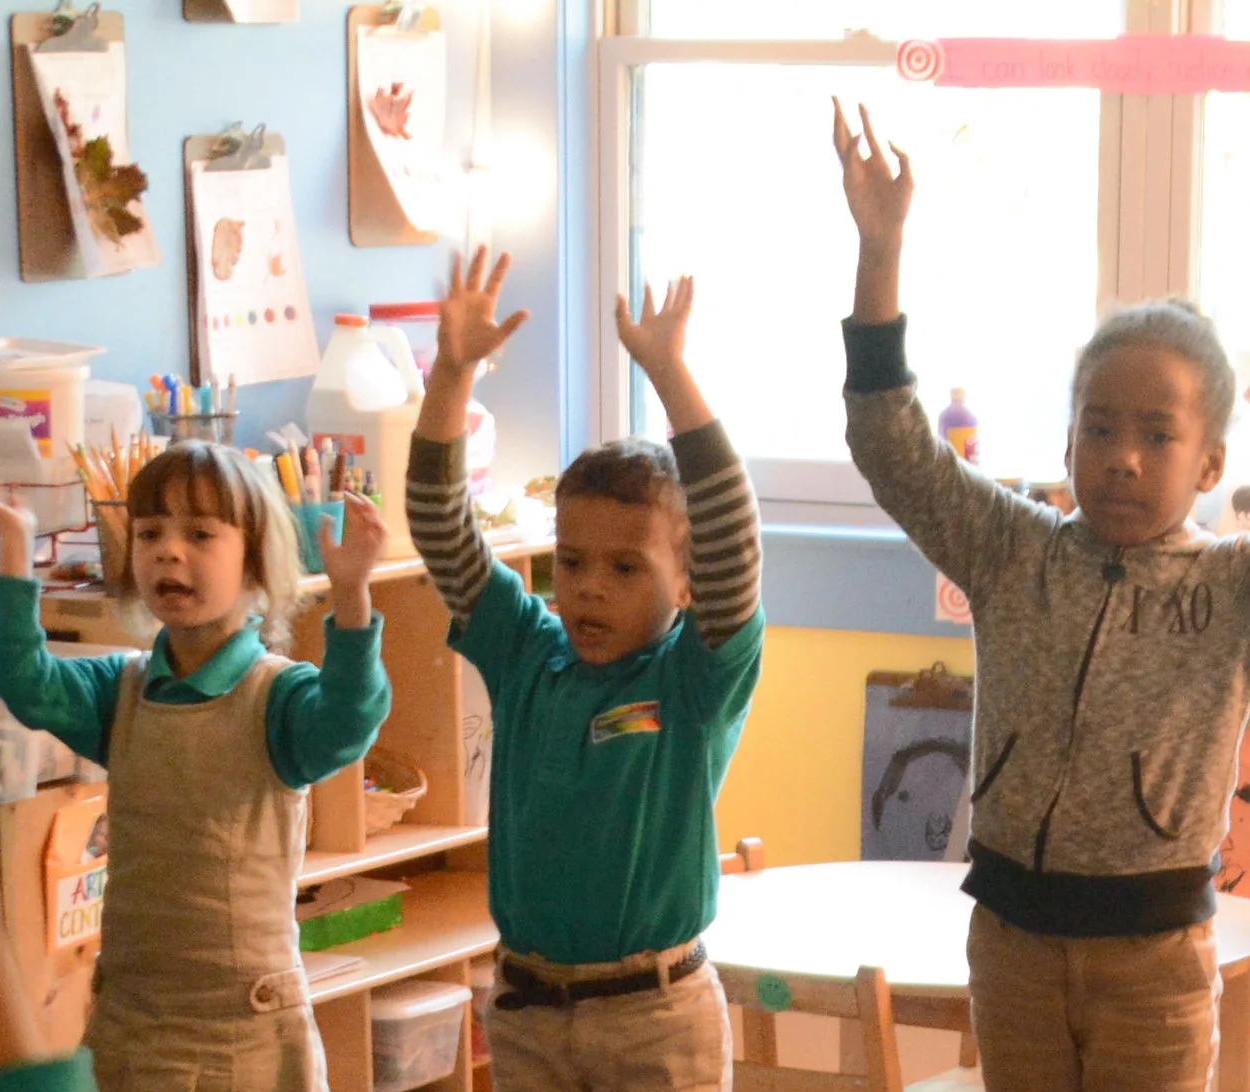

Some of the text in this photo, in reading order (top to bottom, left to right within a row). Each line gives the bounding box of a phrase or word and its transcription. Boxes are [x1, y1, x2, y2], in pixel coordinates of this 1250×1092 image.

[981, 60, 1025, 79] can
[70, 868, 107, 905] ART
[59, 900, 104, 938] CENT
